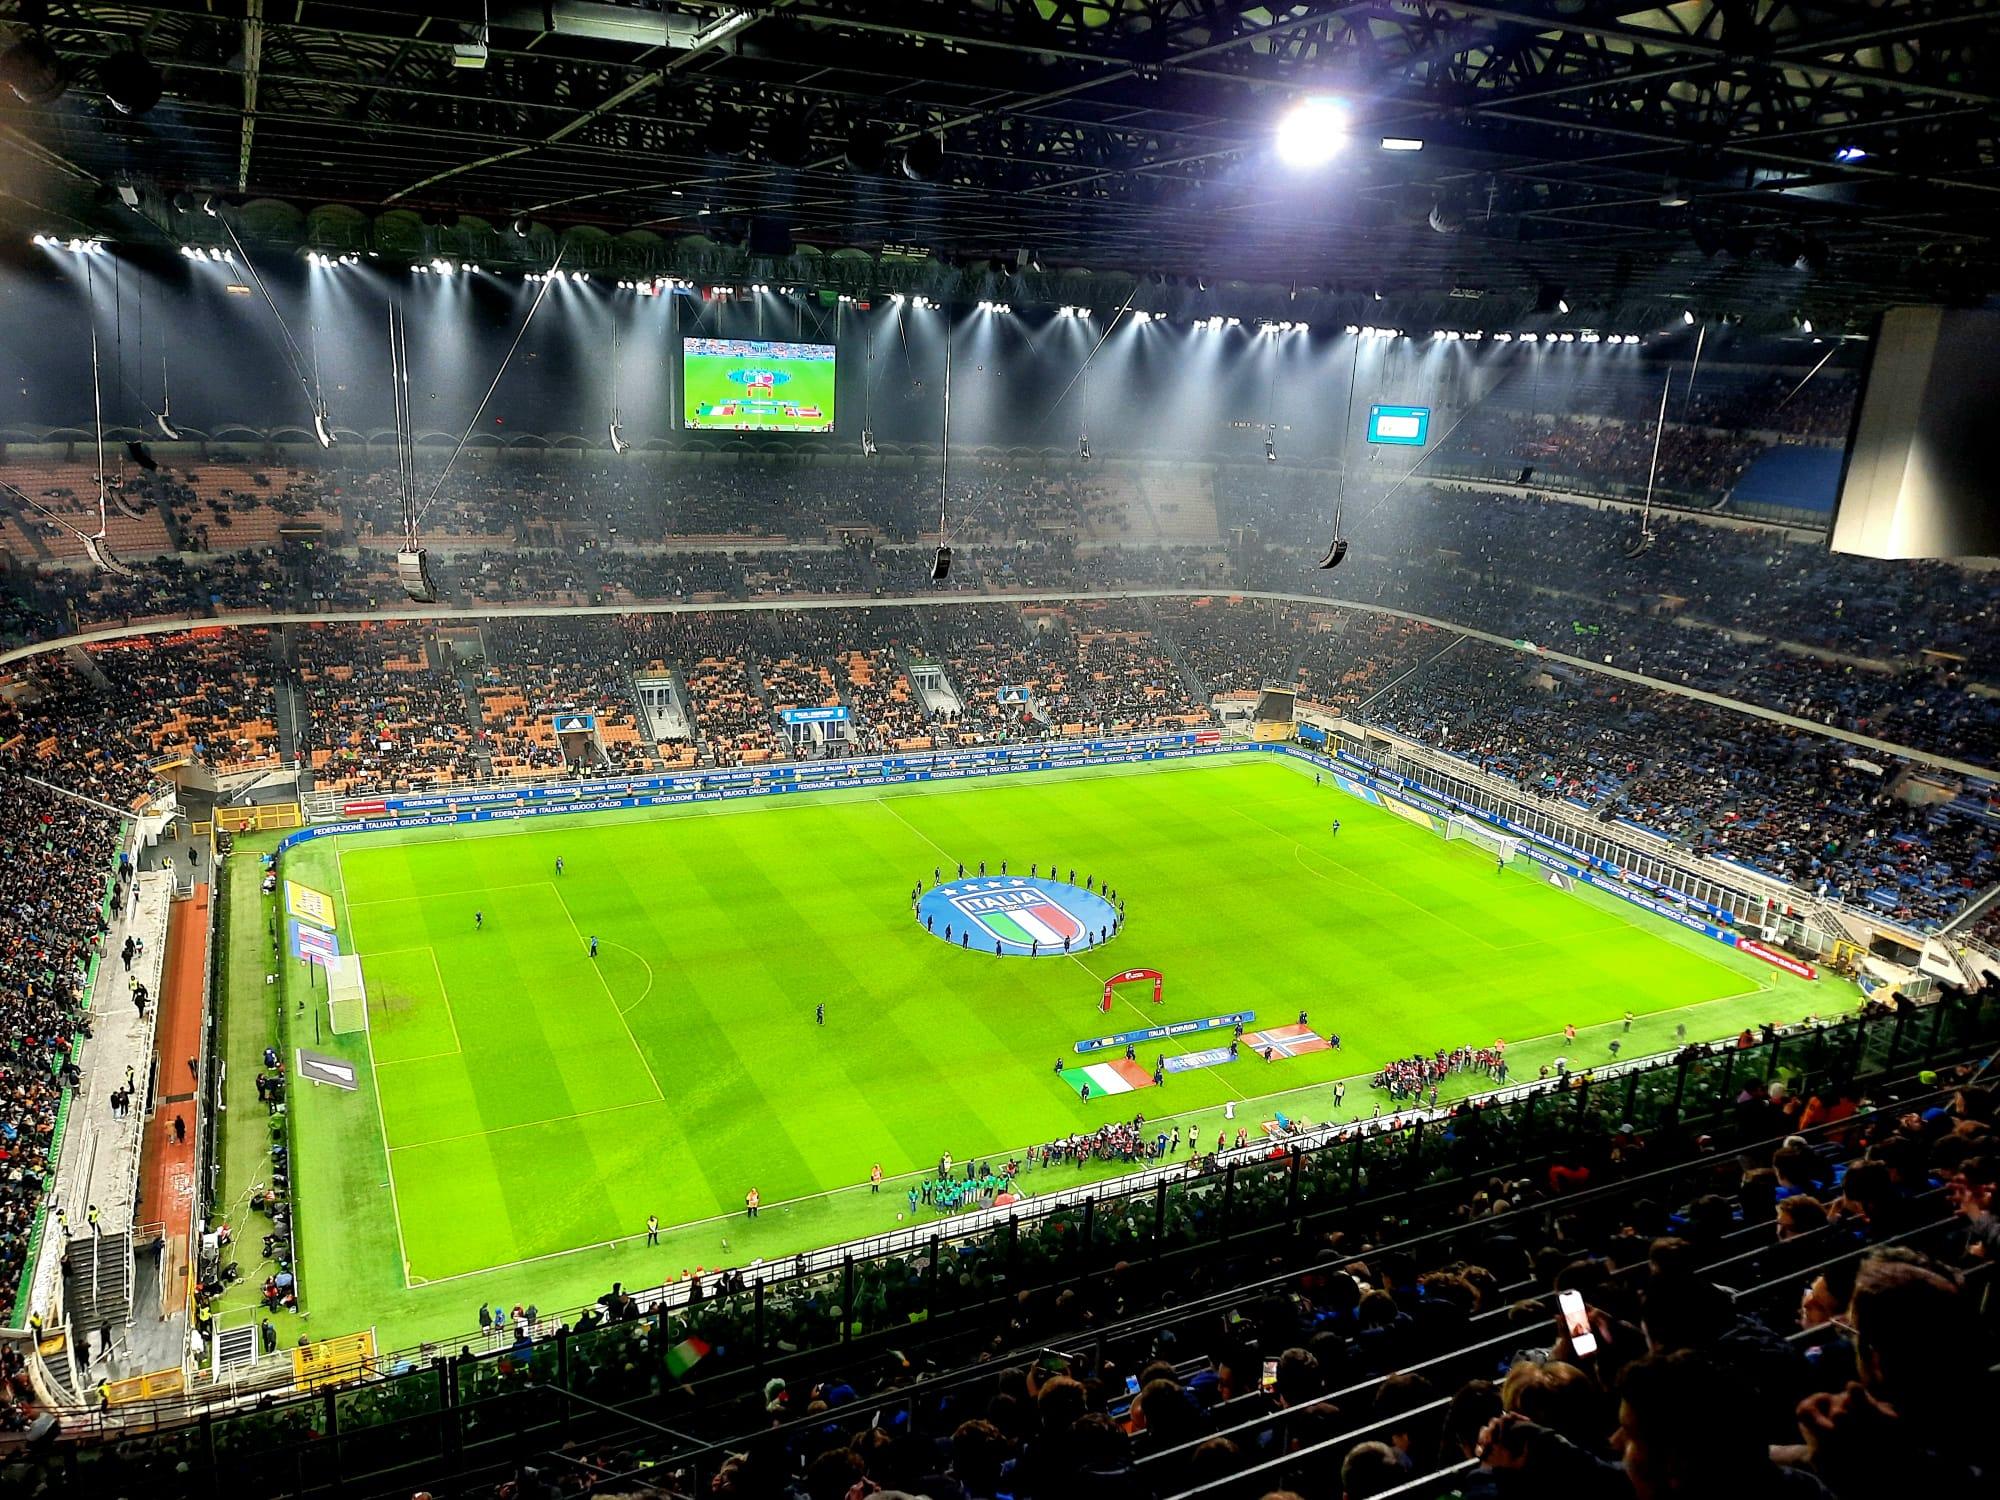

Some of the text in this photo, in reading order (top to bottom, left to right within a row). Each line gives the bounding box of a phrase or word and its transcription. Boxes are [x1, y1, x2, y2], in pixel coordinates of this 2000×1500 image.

[797, 774, 905, 790] FEDERAZIONE ITALIANA GIUOCO CALCIO
[930, 770, 965, 779] FEDERAZIONE
[402, 792, 518, 808] FEDERAZIONE ITALIANA GIUOCO CALCIO
[652, 794, 693, 803] FEDERAZIONE
[695, 791, 722, 800] ITALIANA
[723, 789, 747, 797] GIUOCO
[491, 800, 621, 818] FEDERAZIONE ITALIANA GIUOCO CALCIO
[313, 815, 458, 836] FEDERAZIONE ITALIANA GIUOCO CALCIO
[961, 891, 1043, 912] ITALIA
[1591, 876, 1629, 898] FEDERAZIONE
[1629, 892, 1656, 910] ITALIANA
[1656, 904, 1681, 922] GIUOCO
[1681, 915, 1706, 931] CALCIO
[1148, 1029, 1165, 1038] ITALIA
[1171, 1022, 1197, 1034] NORVEGIA
